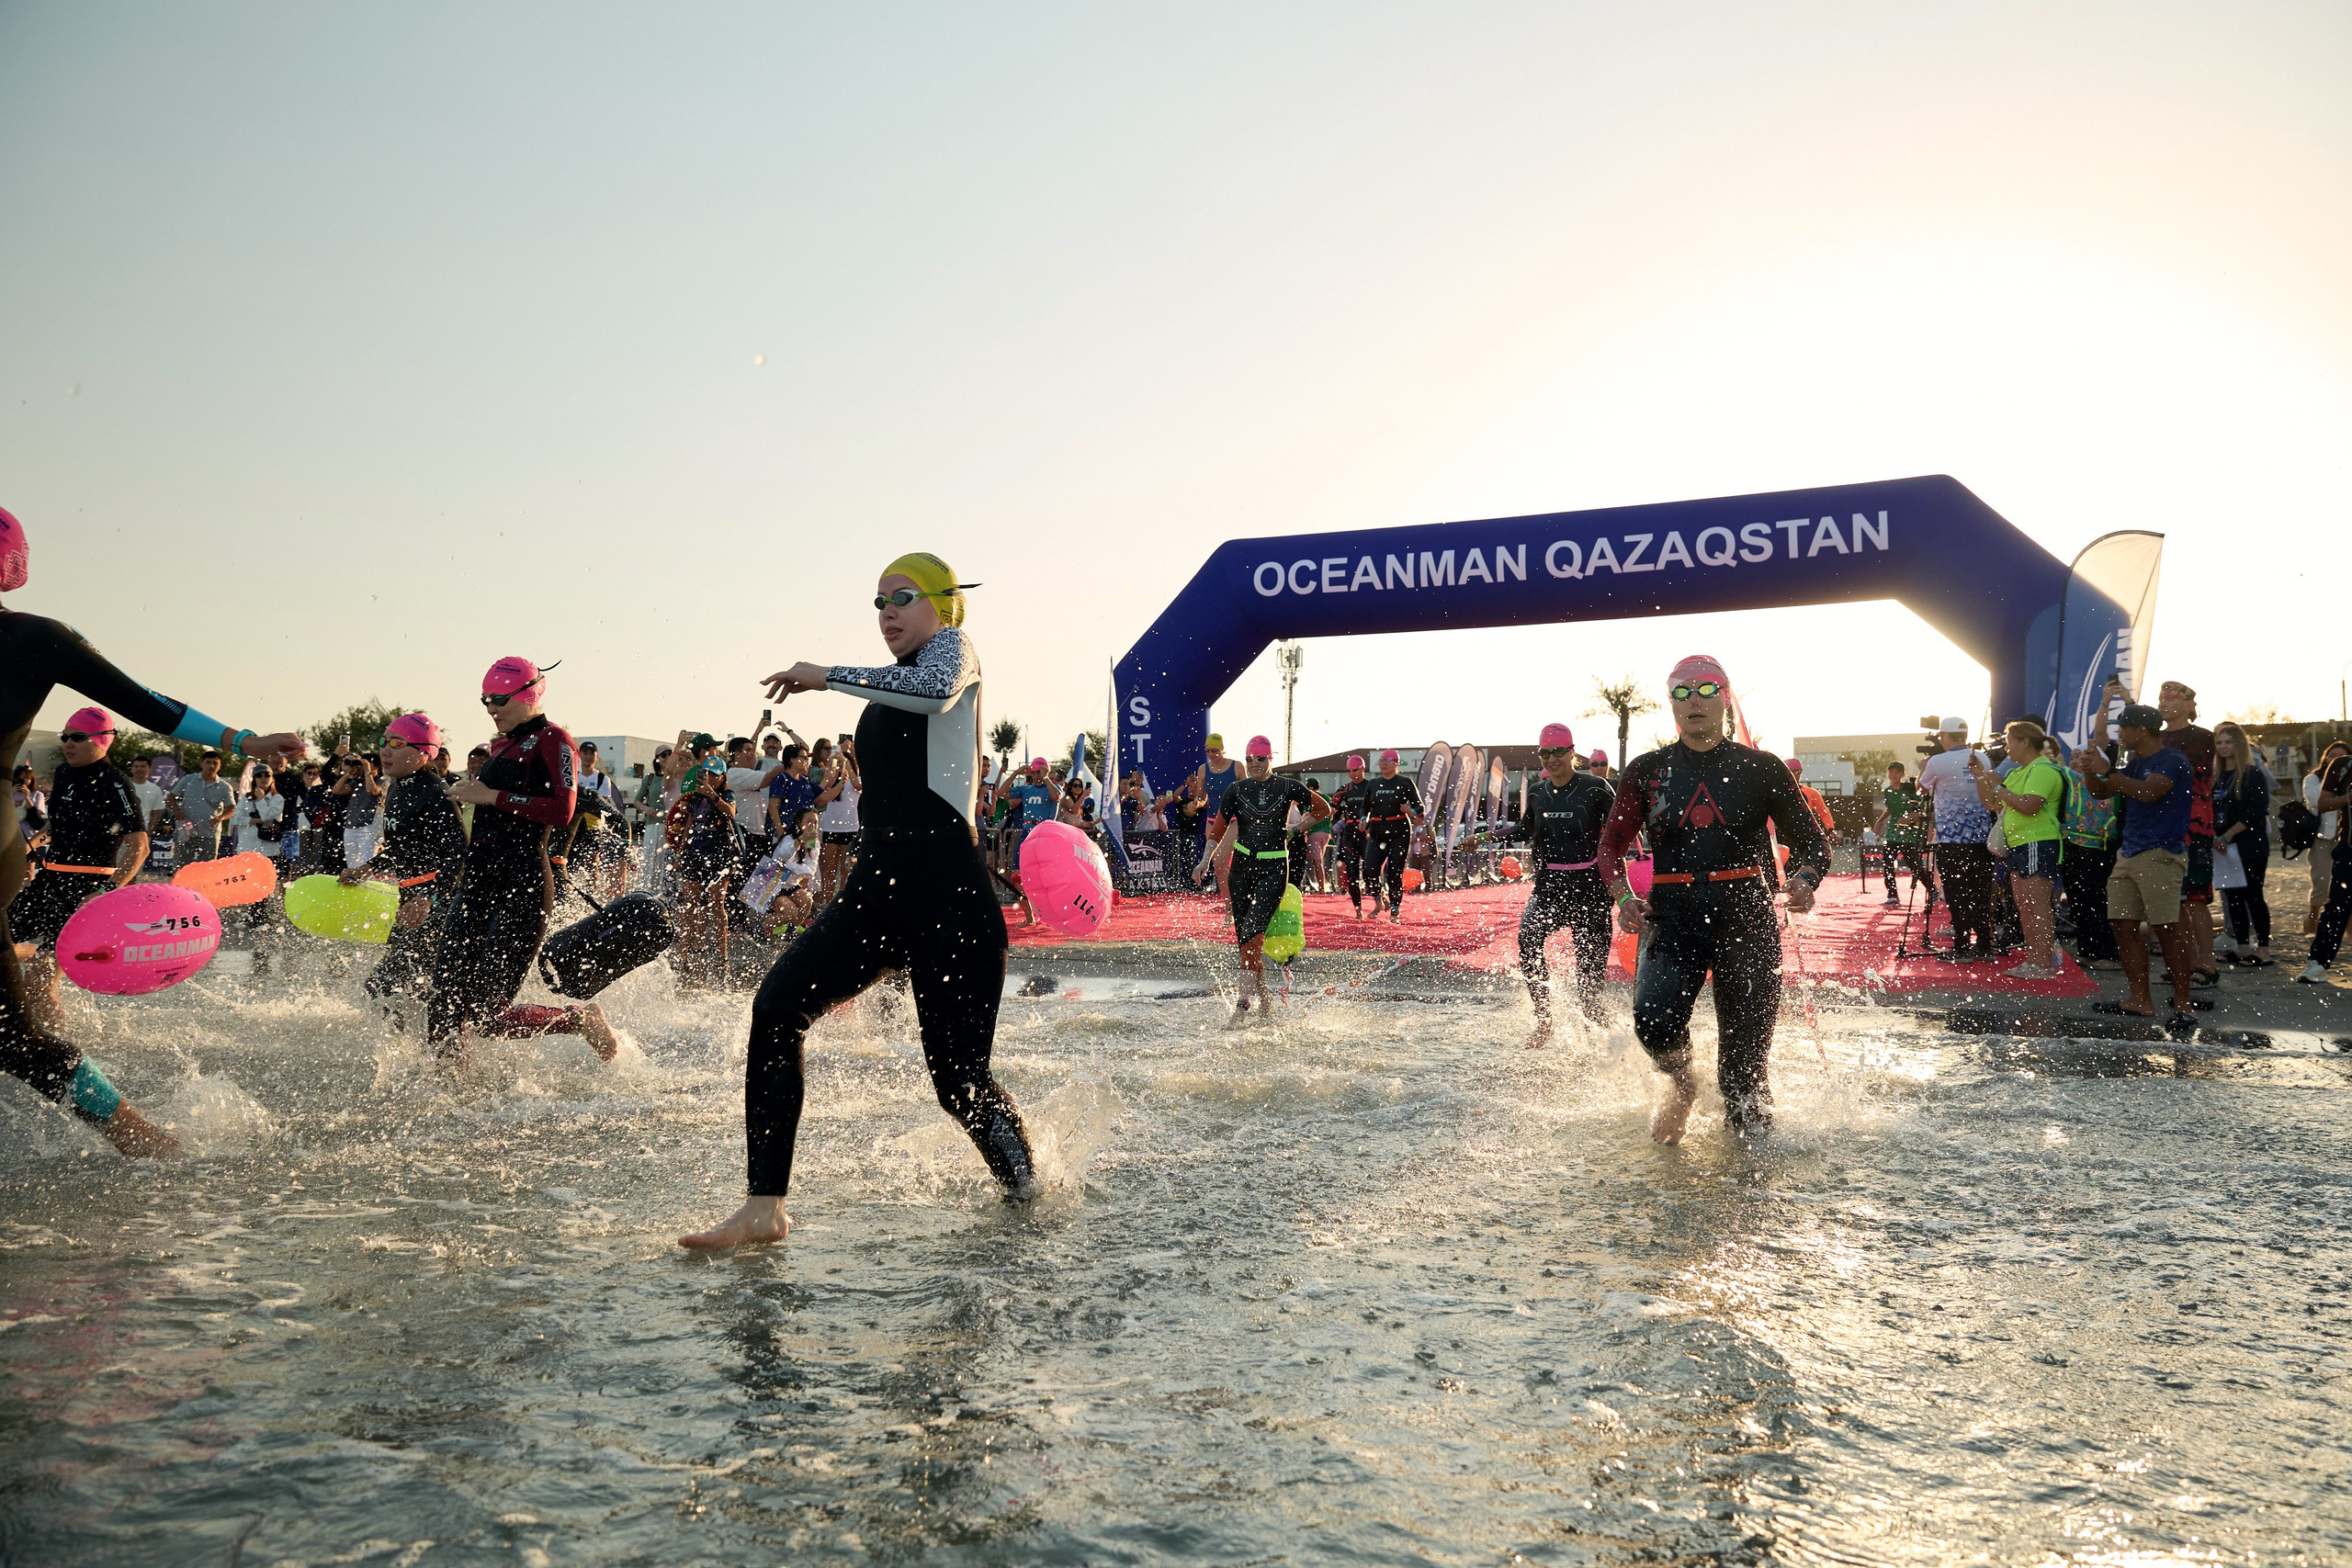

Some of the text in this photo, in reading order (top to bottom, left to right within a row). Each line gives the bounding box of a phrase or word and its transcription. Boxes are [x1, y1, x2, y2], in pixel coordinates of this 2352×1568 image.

[1253, 510, 1890, 597] OCEANMAN QAZAQSTAN
[561, 753, 574, 788] 749
[383, 817, 397, 831] TYR
[223, 874, 247, 886] 762
[1129, 876, 1168, 890] AKTAU
[1073, 895, 1095, 916] 911
[166, 915, 201, 931] 756
[123, 933, 216, 963] OCEANMAN
